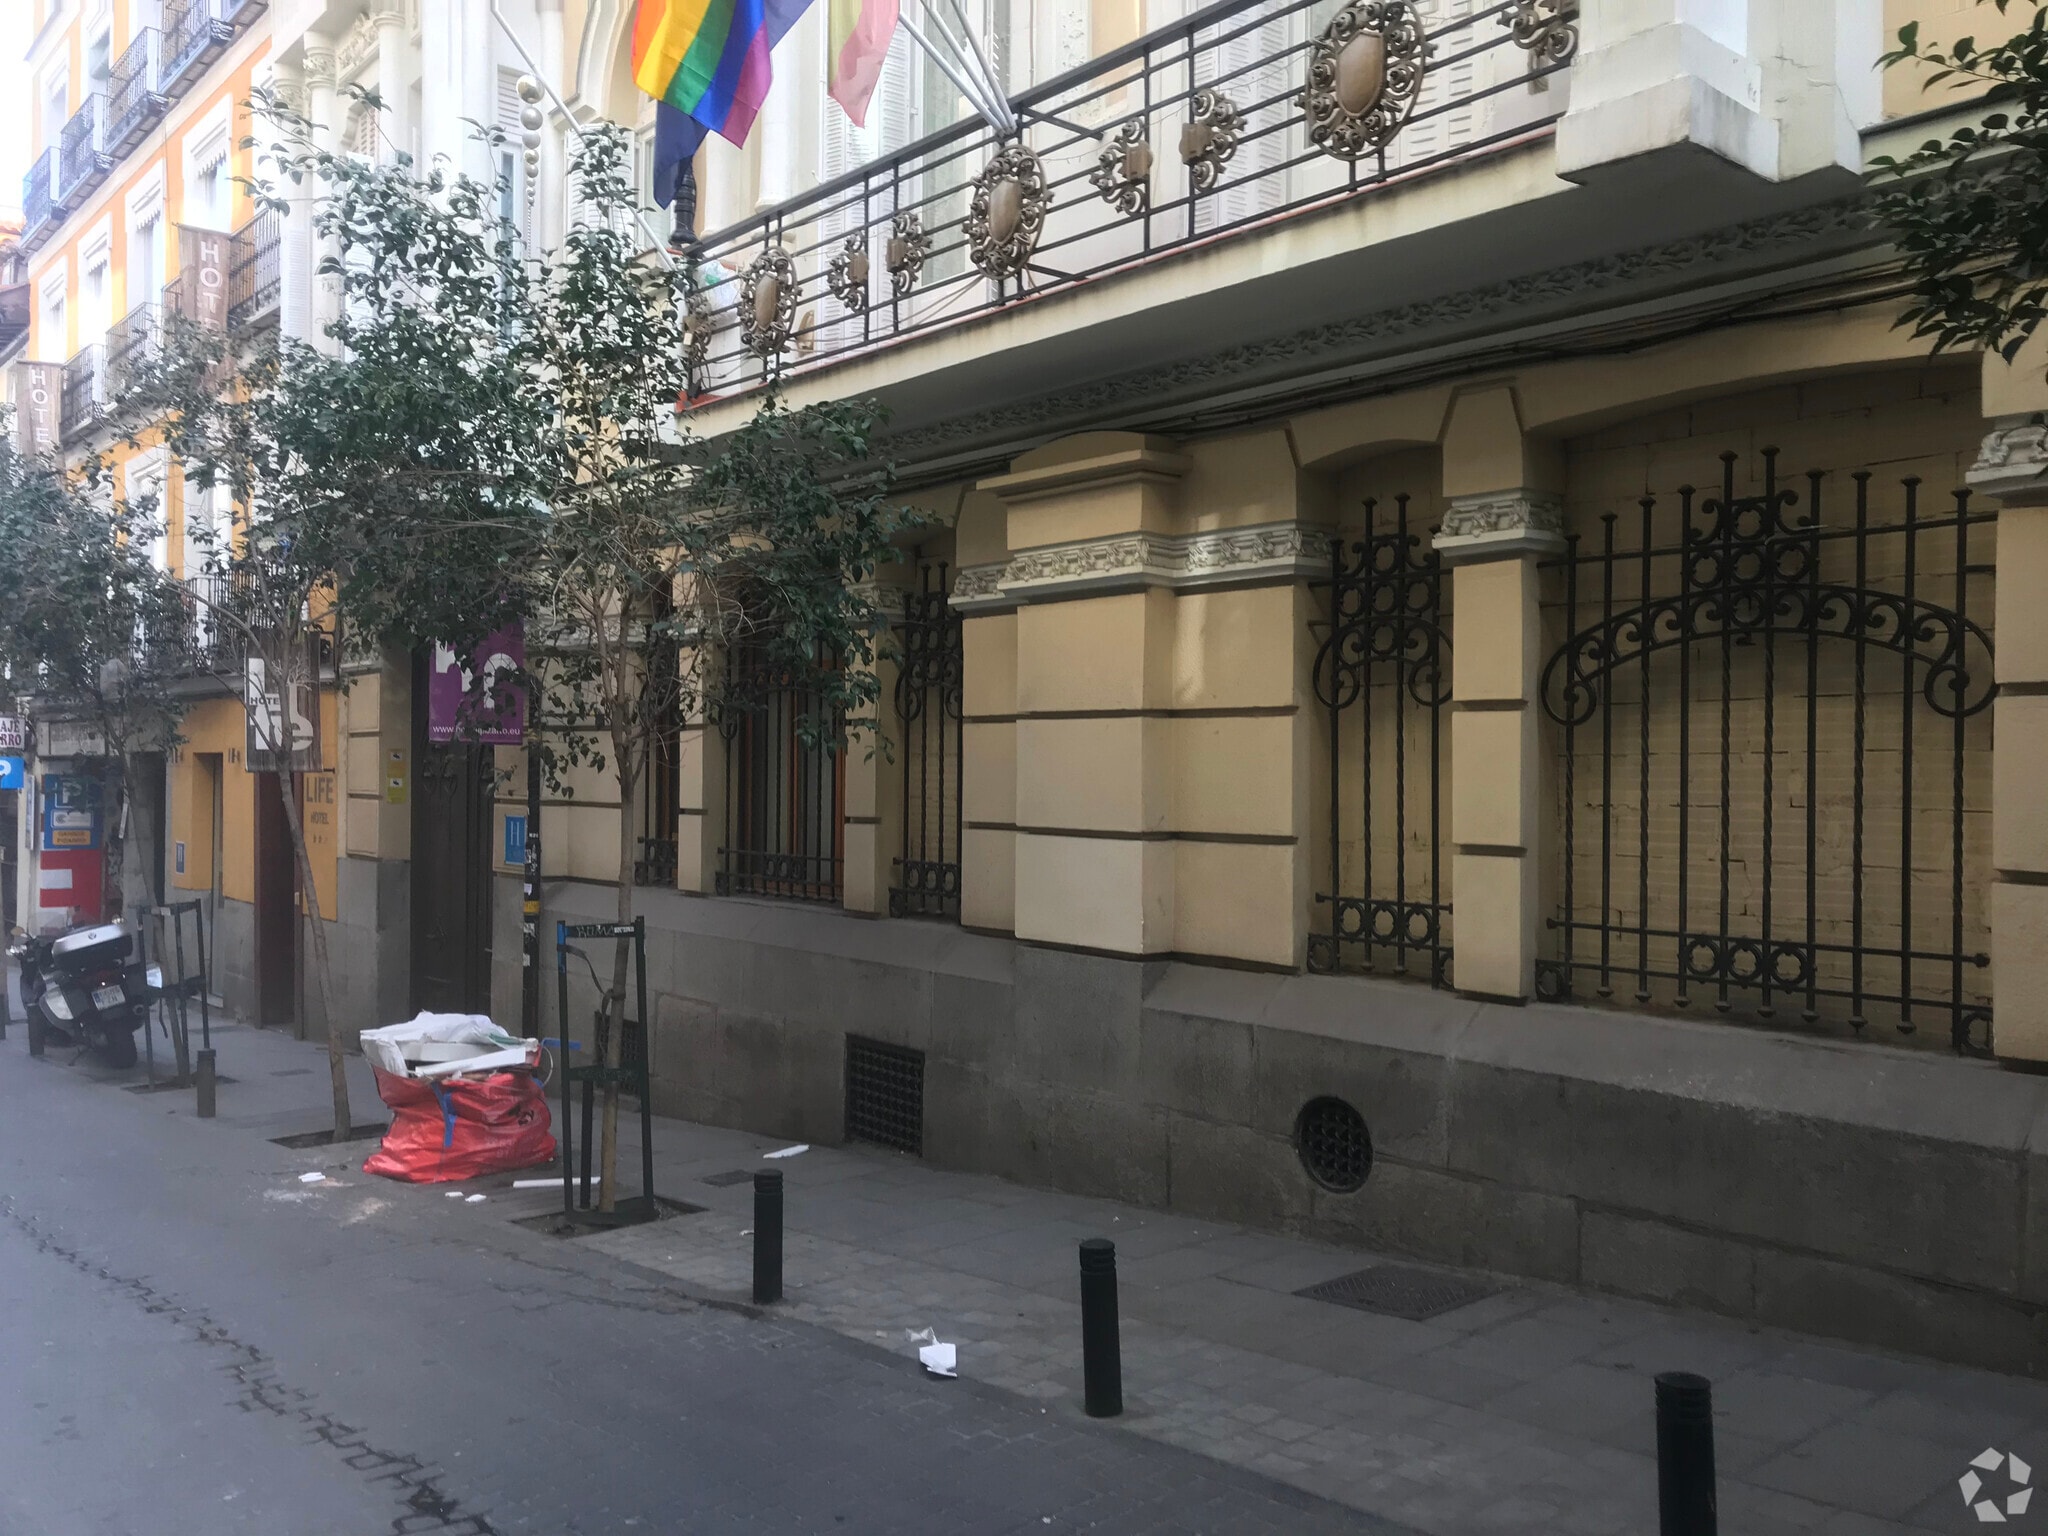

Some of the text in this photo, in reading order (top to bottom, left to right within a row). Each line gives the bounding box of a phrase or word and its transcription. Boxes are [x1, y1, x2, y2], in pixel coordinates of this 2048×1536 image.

[200, 240, 222, 365] HOTE
[31, 369, 50, 454] HOTE
[250, 697, 280, 706] HOTE
[307, 777, 334, 804] LIFE
